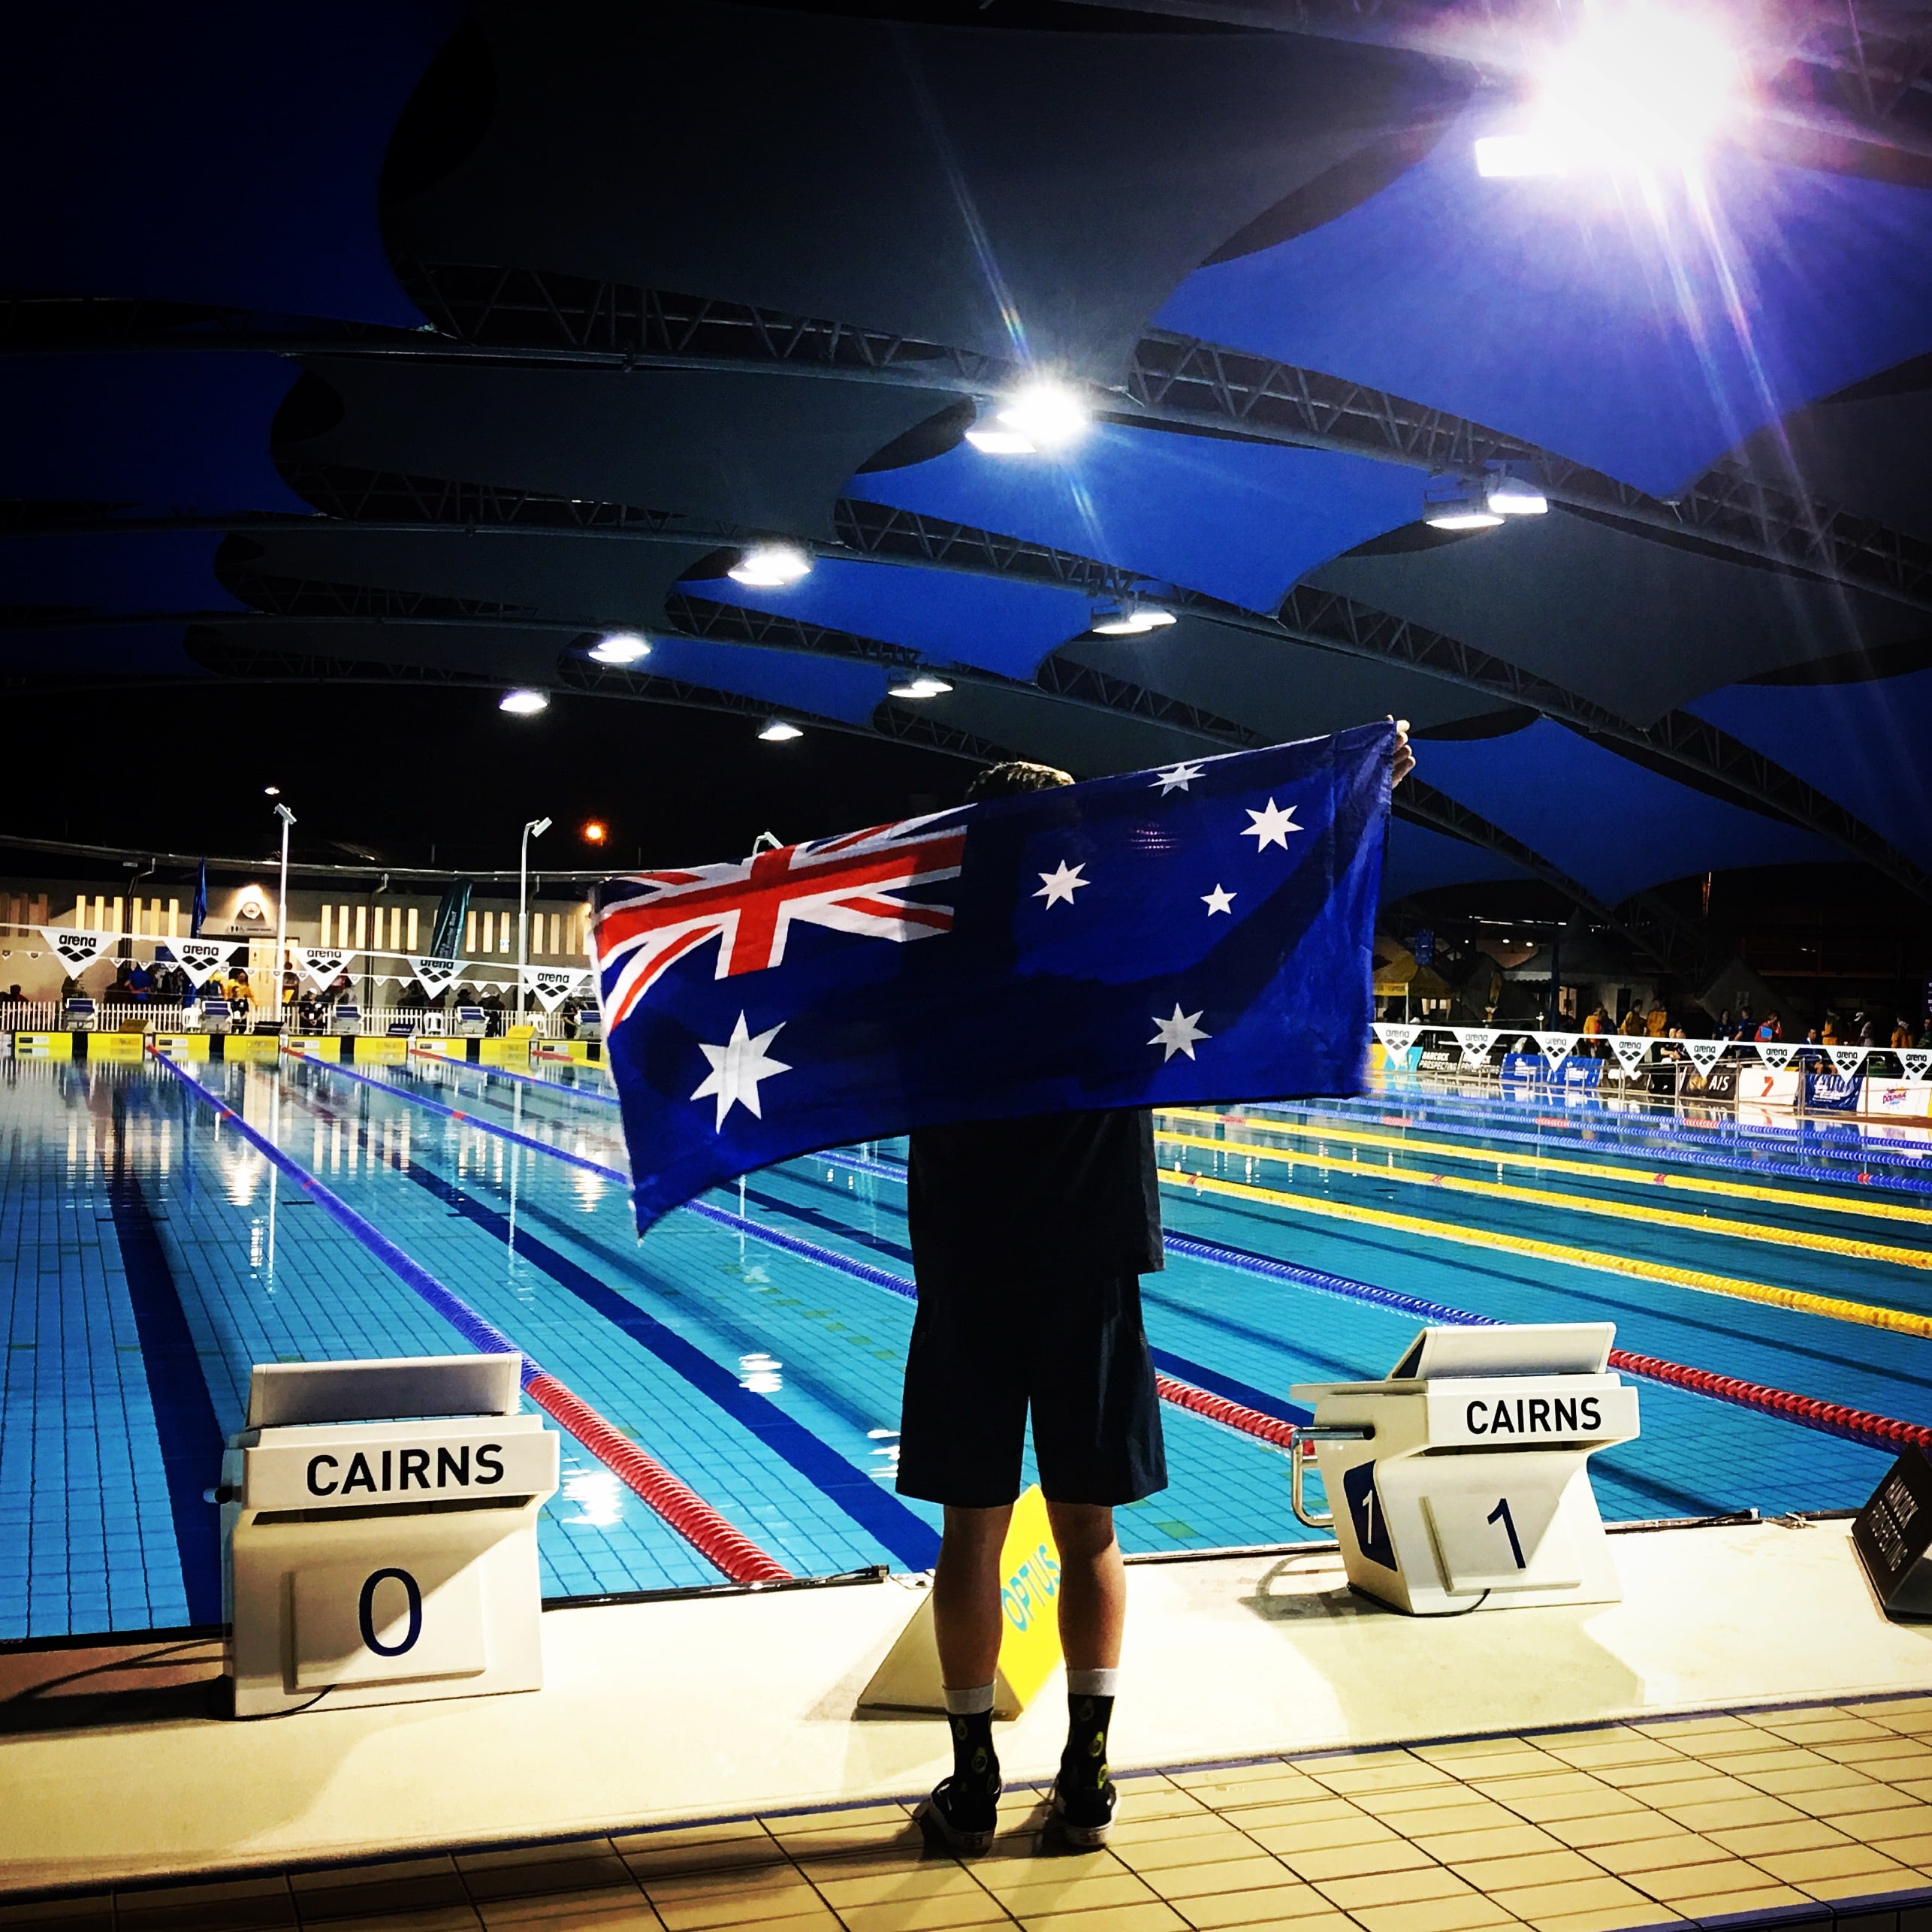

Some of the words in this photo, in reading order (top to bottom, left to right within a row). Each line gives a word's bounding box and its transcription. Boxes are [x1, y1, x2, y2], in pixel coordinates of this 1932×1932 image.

[59, 934, 97, 948] arena
[183, 943, 219, 956] arena
[307, 950, 342, 958] arena
[537, 973, 570, 983] arena
[1385, 1029, 1410, 1038] arena
[1465, 1033, 1488, 1042] arena
[1545, 1037, 1567, 1046] arena
[1619, 1040, 1641, 1049] arena
[1694, 1045, 1716, 1053] arena
[1766, 1048, 1788, 1056] arena
[1837, 1051, 1858, 1059] arena
[1708, 1075, 1730, 1091] AIS
[1761, 1076, 1774, 1097] 7
[1466, 1397, 1601, 1435] CAIRNS
[306, 1444, 504, 1497] CAIRNS
[1885, 1475, 1919, 1529] HANCOCK
[1362, 1490, 1373, 1544] 1
[1487, 1498, 1526, 1569] 1
[1866, 1499, 1909, 1572] PROSPECTING
[1001, 1544, 1061, 1632] OPTUS
[358, 1567, 422, 1657] 0
